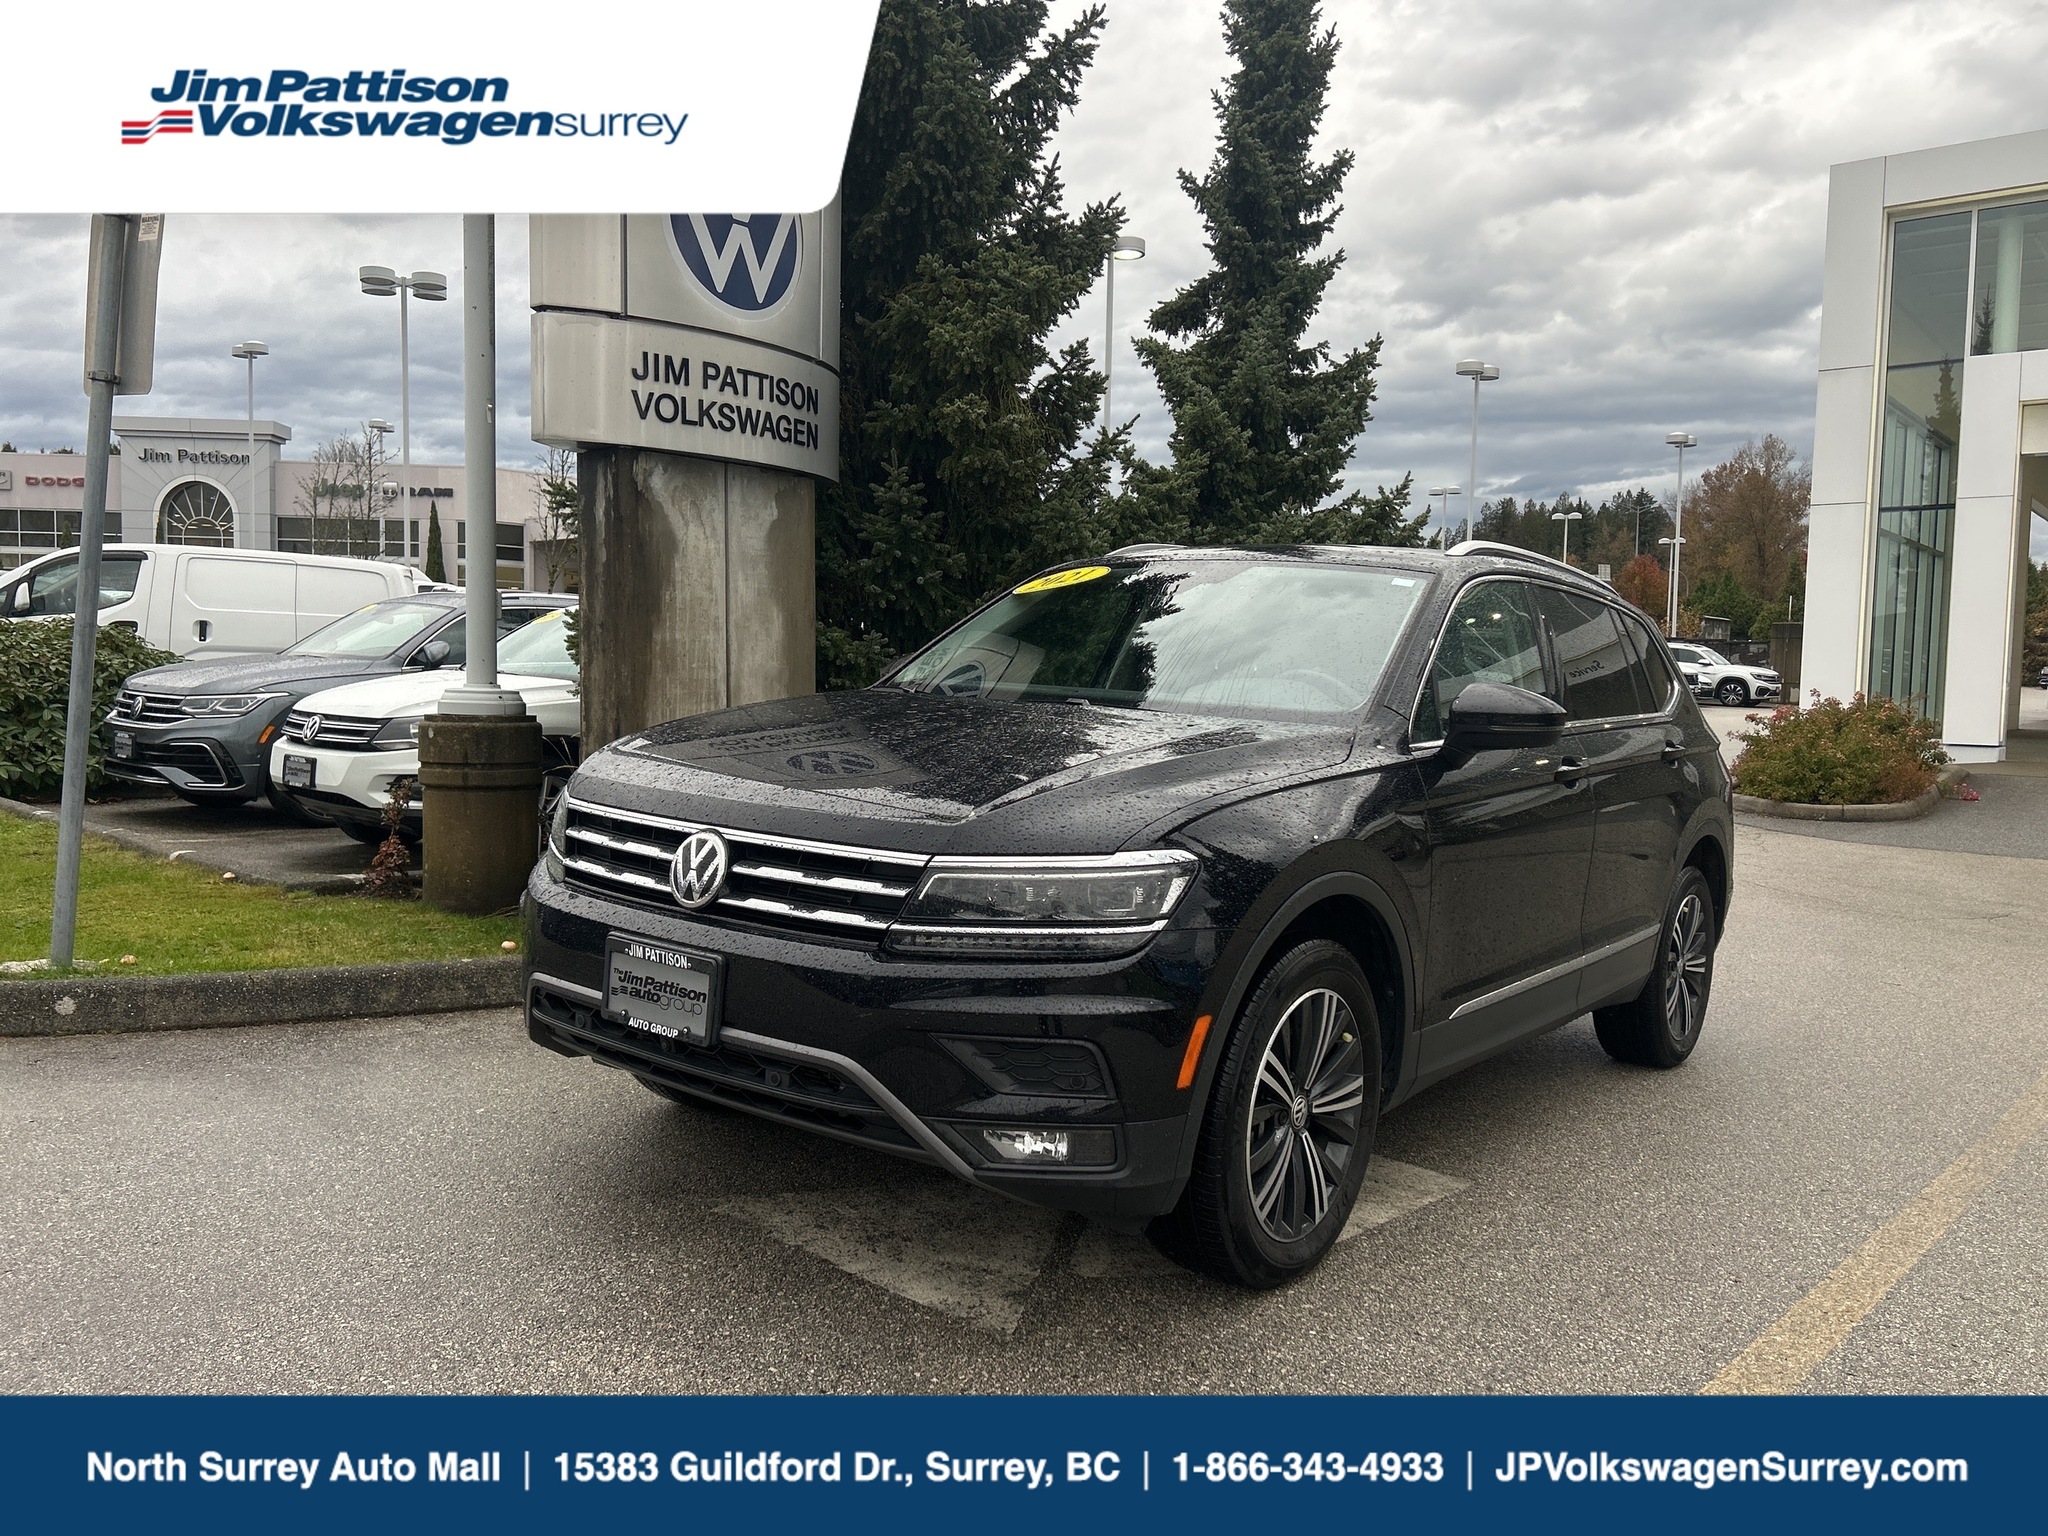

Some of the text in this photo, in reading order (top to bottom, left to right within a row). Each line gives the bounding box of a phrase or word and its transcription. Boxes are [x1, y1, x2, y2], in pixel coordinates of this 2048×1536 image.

[631, 352, 819, 415] JIM PATTISON
[631, 389, 819, 450] VOLKSWAGEN
[138, 448, 249, 464] Jim Pattison
[25, 475, 84, 487] DODG
[628, 943, 687, 969] JIM PATTISON
[613, 967, 624, 975] The
[628, 1016, 679, 1038] AUTO GROUP
